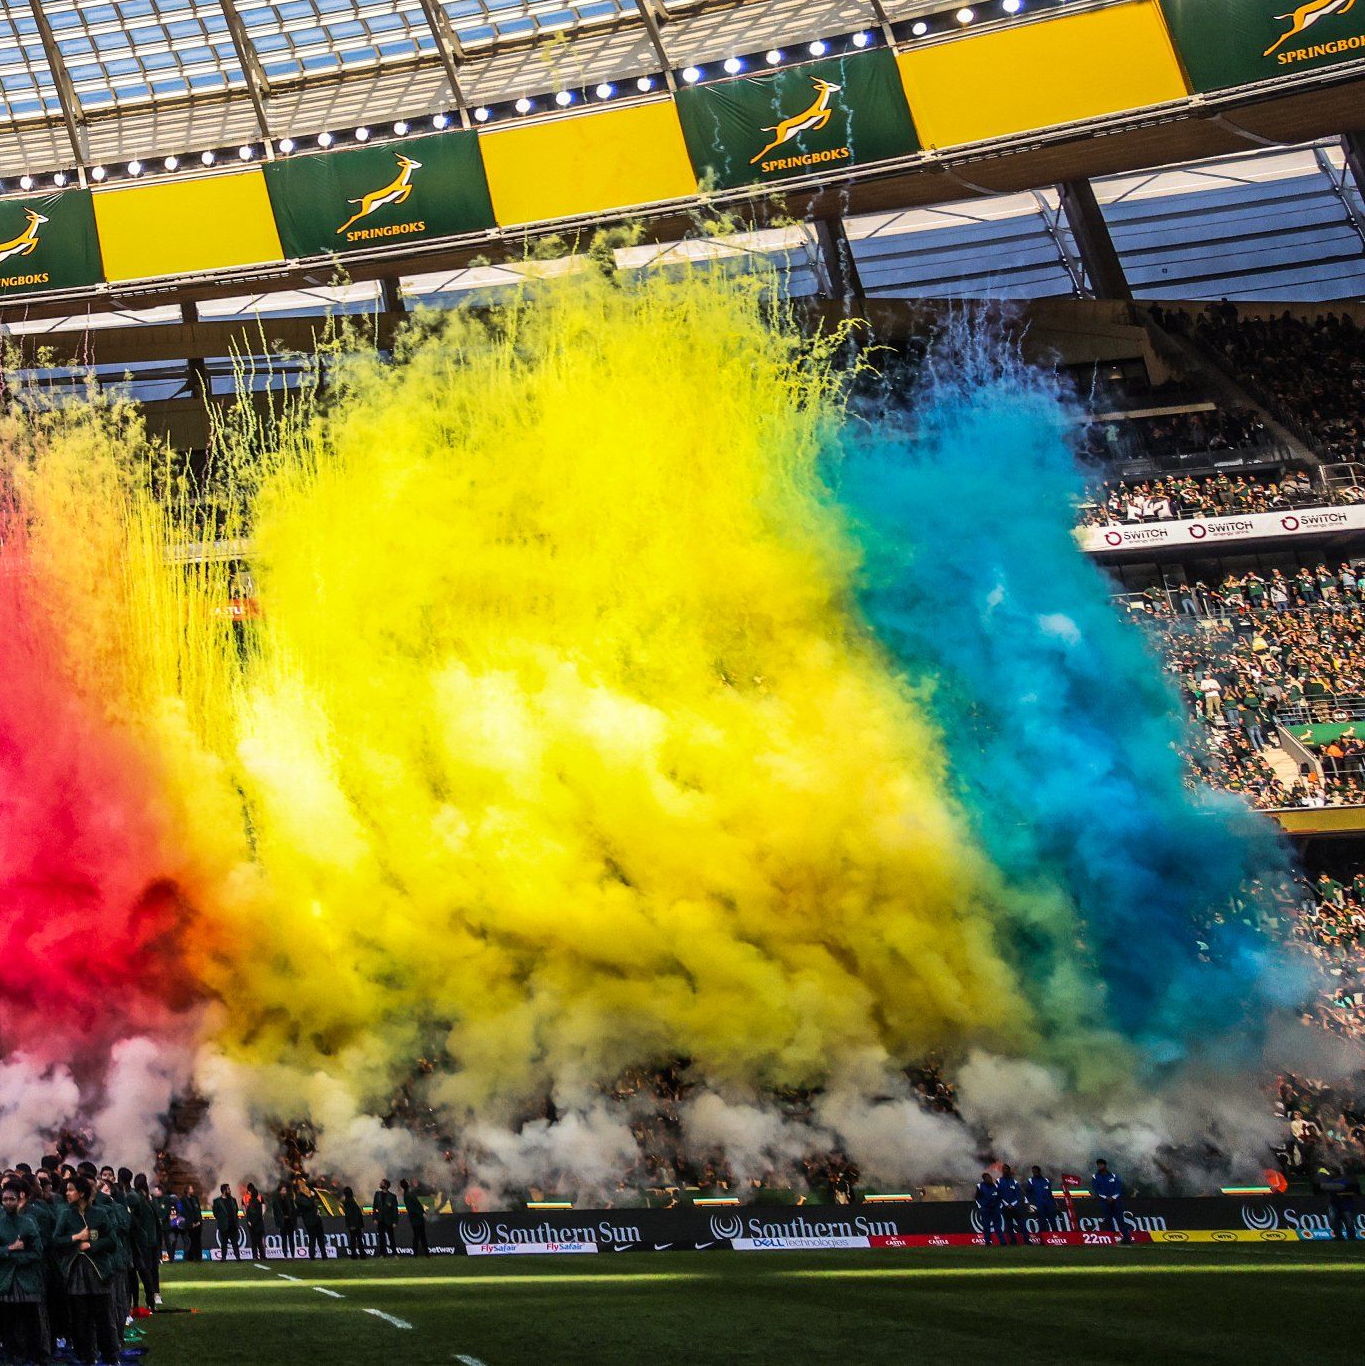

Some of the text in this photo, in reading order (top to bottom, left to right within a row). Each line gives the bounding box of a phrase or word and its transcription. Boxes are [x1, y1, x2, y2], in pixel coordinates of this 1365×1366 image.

[761, 147, 850, 172] SPRINGBOKS
[346, 221, 426, 242] SPRINGBOKS
[1207, 521, 1253, 533] SWITCH
[1123, 528, 1168, 540] SWITCH
[1122, 1210, 1167, 1232] Sun
[495, 1221, 643, 1243] Southern Sun
[748, 1216, 899, 1239] Southern Sun
[753, 1238, 849, 1248] DELL Technologies
[1082, 1233, 1112, 1244] 22m
[481, 1244, 517, 1254] FlySafair
[546, 1242, 583, 1252] FlySafair
